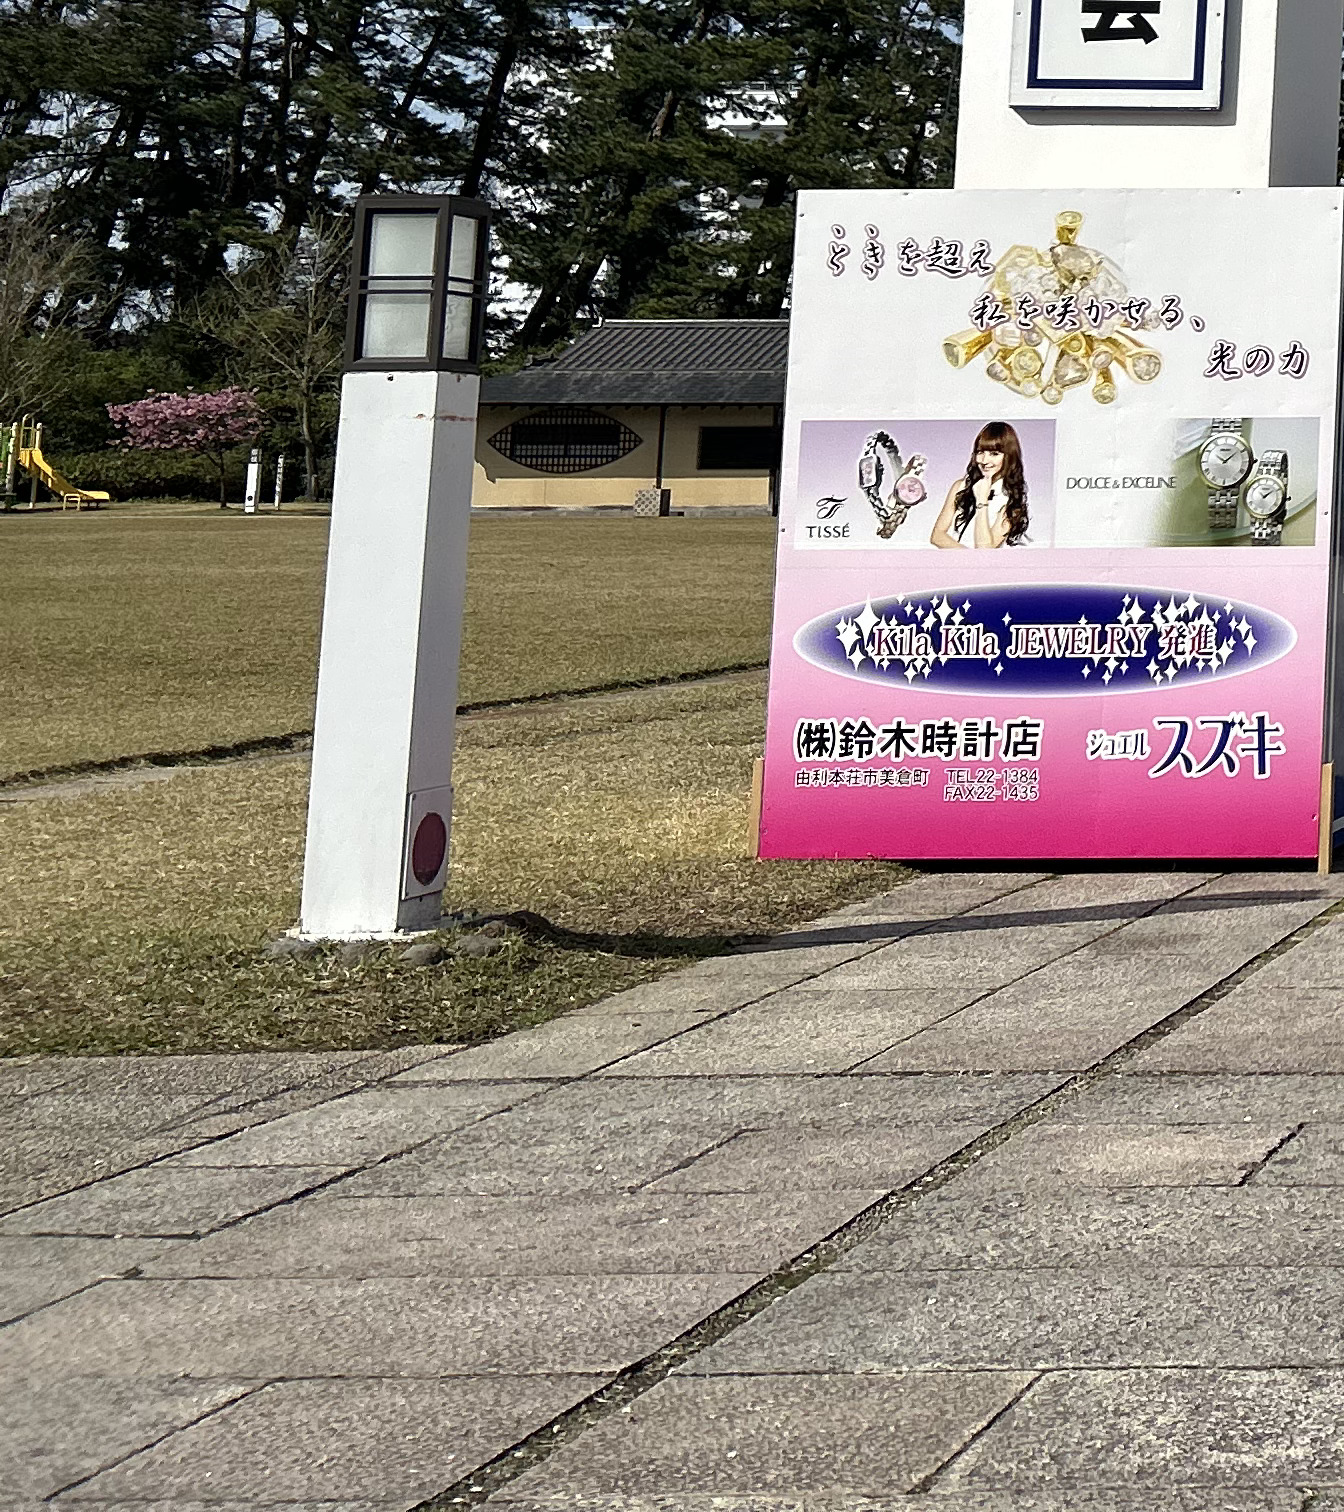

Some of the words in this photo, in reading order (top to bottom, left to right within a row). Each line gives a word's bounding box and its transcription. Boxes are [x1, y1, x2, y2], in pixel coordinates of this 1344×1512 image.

[826, 224, 995, 281] ときを超え
[971, 294, 1206, 333] 私を咲かせる、
[1204, 340, 1311, 379] 光の力
[1066, 477, 1111, 489] DOLCE
[1112, 479, 1121, 489] &
[1122, 476, 1178, 489] EXCELINE
[805, 522, 850, 538] TISSÉ
[872, 624, 931, 658] Kila
[940, 624, 998, 658] Kila
[1006, 623, 1153, 658] JEWELRY
[1158, 622, 1218, 659] 発進
[1090, 732, 1148, 756] ジュエル
[1151, 714, 1282, 775] スズキ
[796, 768, 930, 786] 由利本荘市美倉町
